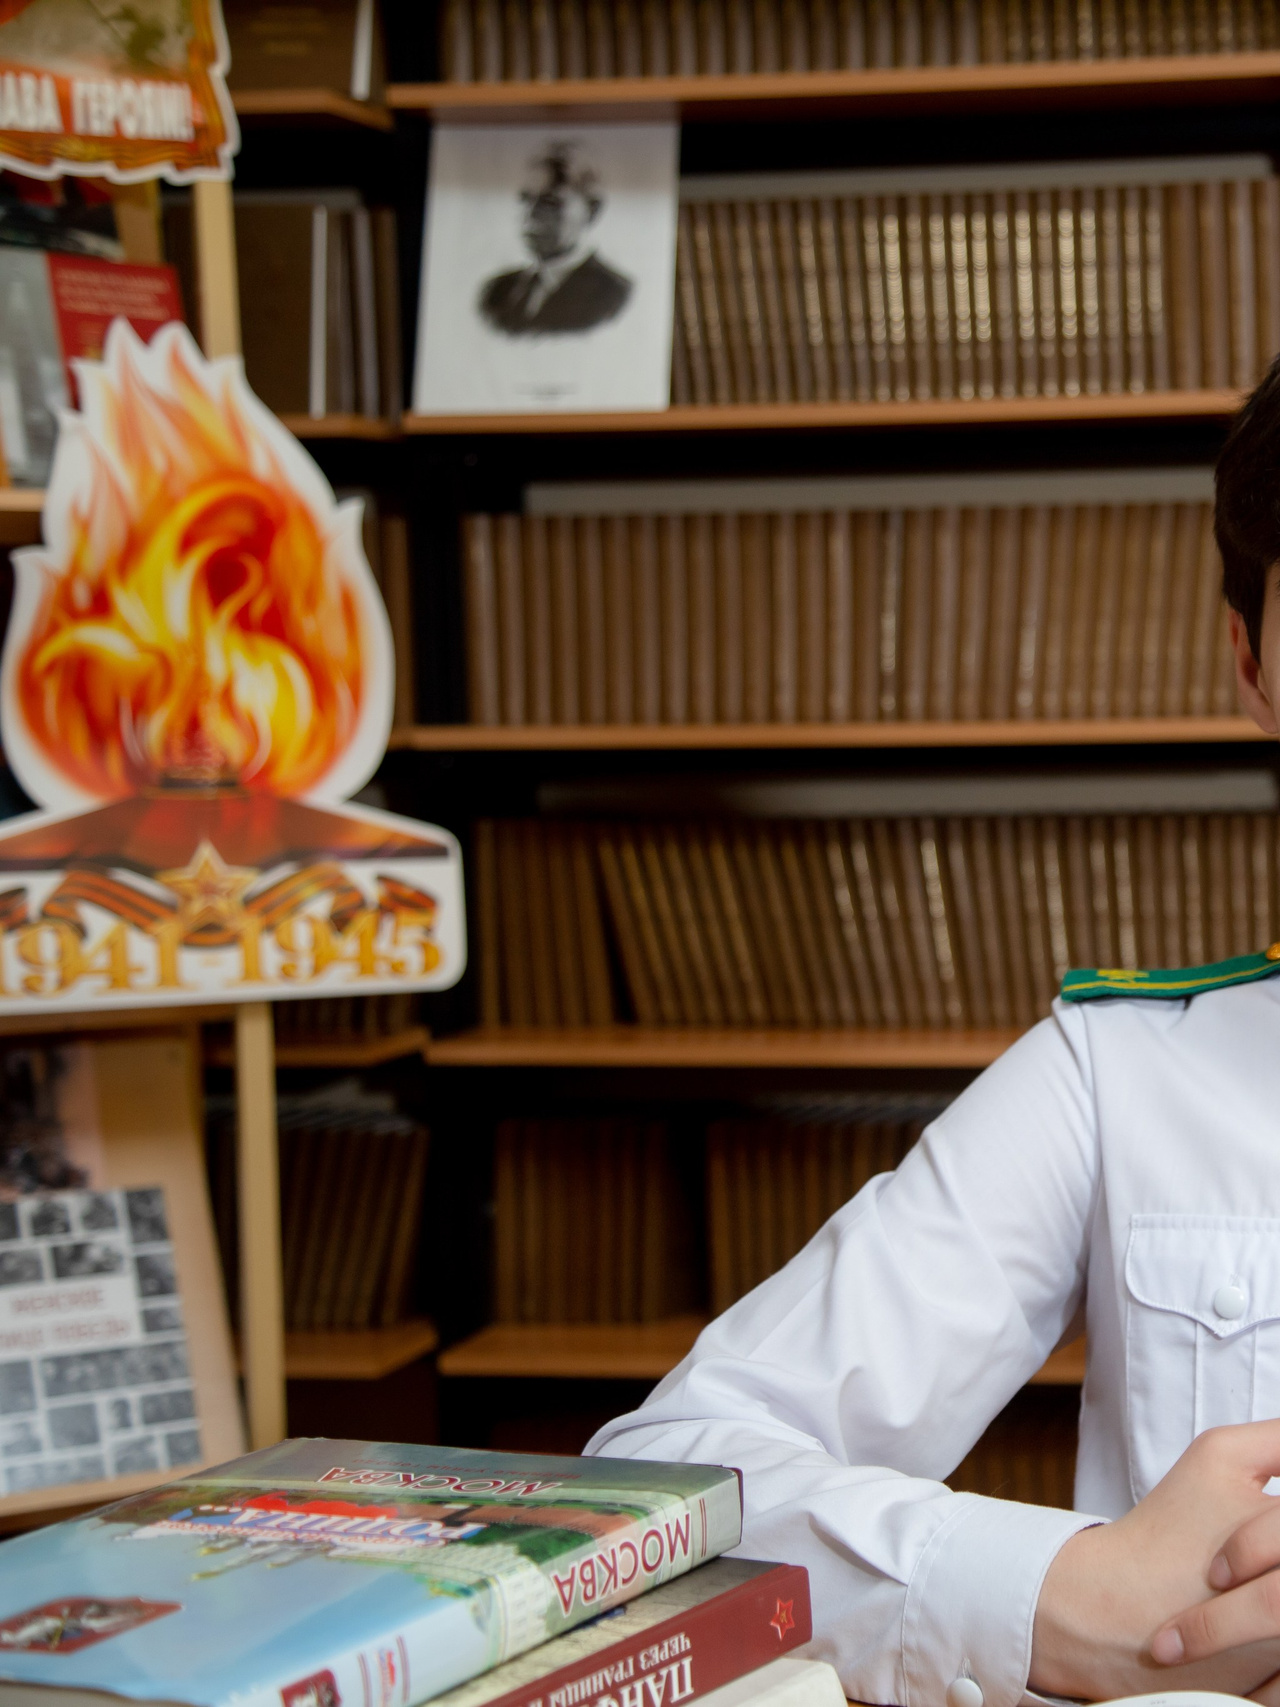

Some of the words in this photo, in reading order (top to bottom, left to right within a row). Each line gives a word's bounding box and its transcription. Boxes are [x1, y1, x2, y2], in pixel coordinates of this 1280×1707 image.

[317, 1467, 562, 1496] МОСКВА
[552, 1511, 691, 1617] МОСКВА
[639, 1632, 692, 1671] ЧЕРЕЗ
